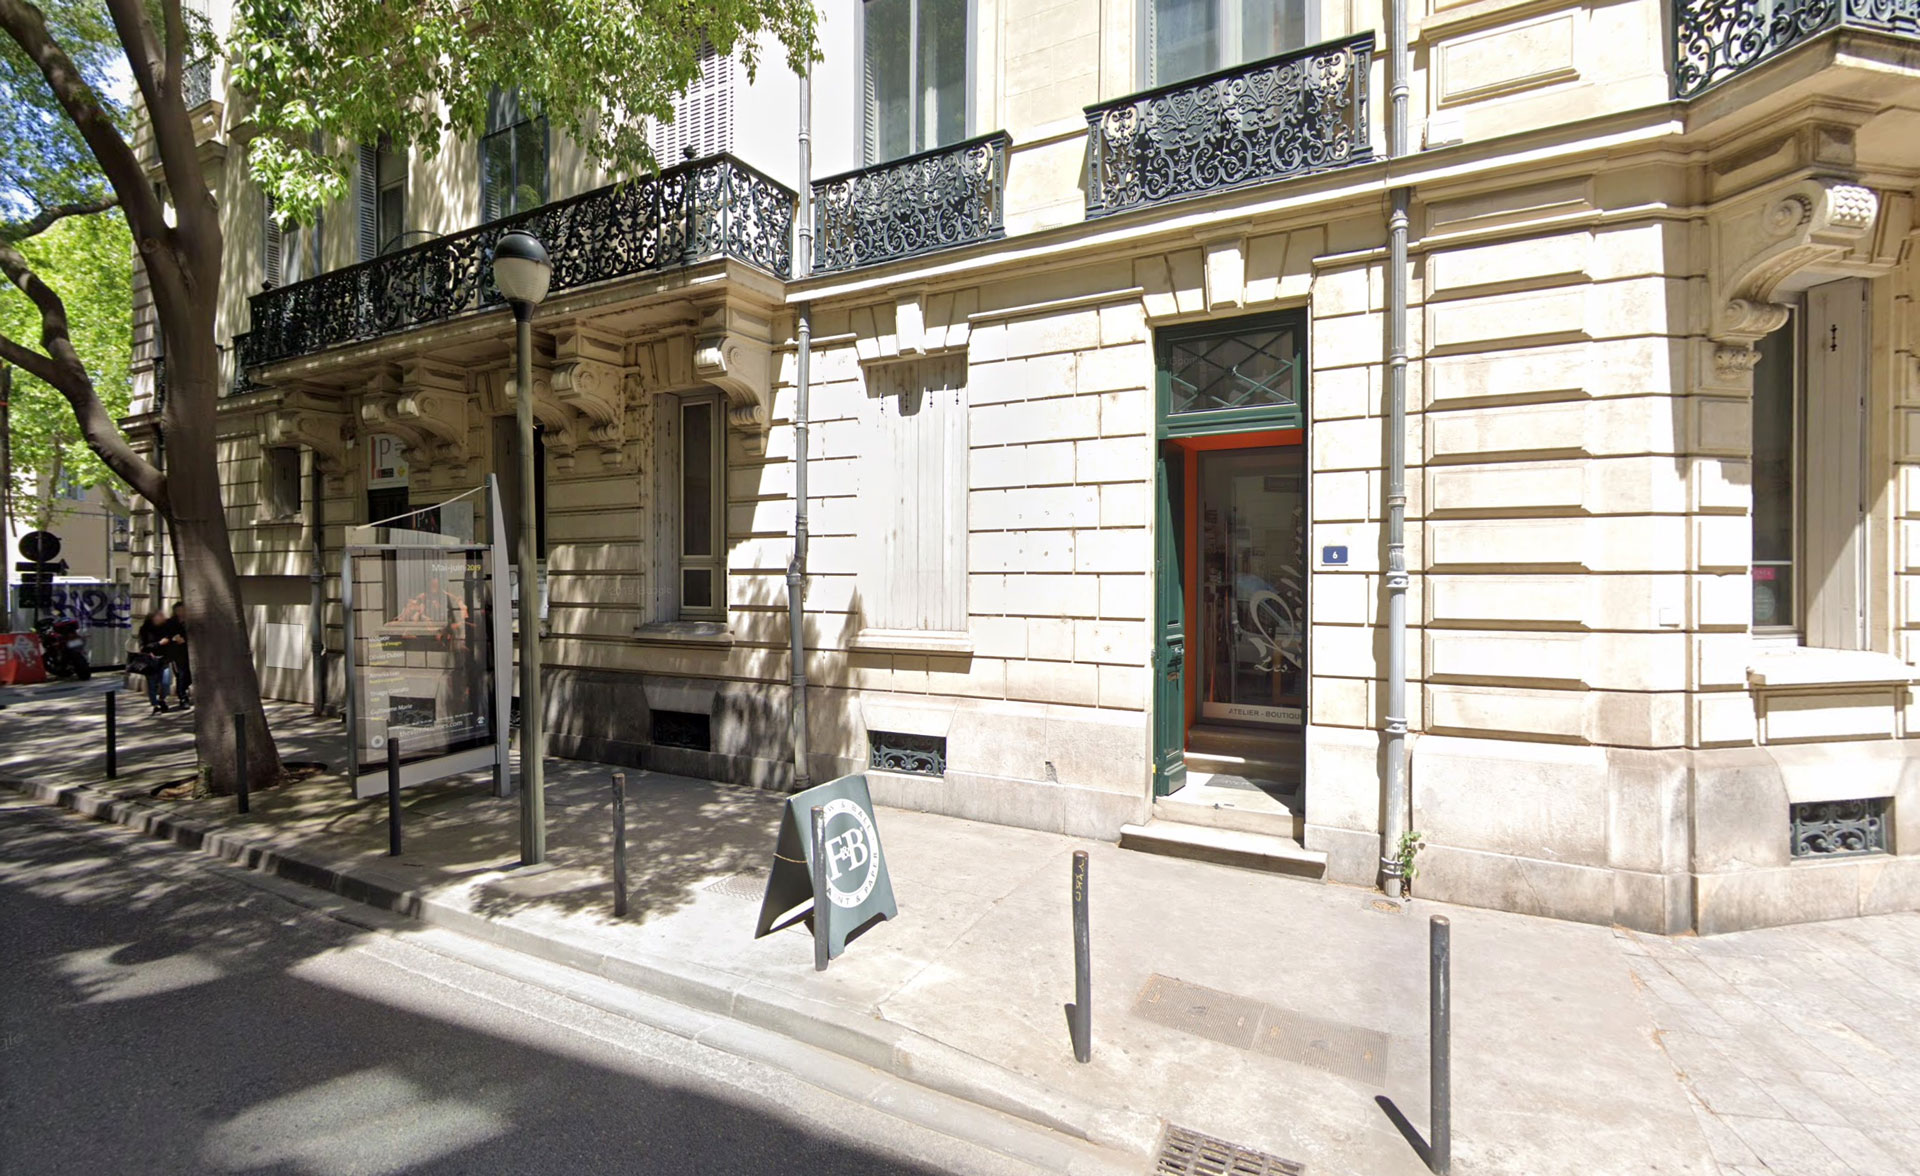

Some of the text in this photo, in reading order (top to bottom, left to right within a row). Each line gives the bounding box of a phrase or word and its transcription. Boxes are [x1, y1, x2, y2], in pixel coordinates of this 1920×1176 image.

[1332, 551, 1338, 560] 6
[1229, 708, 1259, 717] ATELIER
[1266, 711, 1301, 720] BOUTIQU
